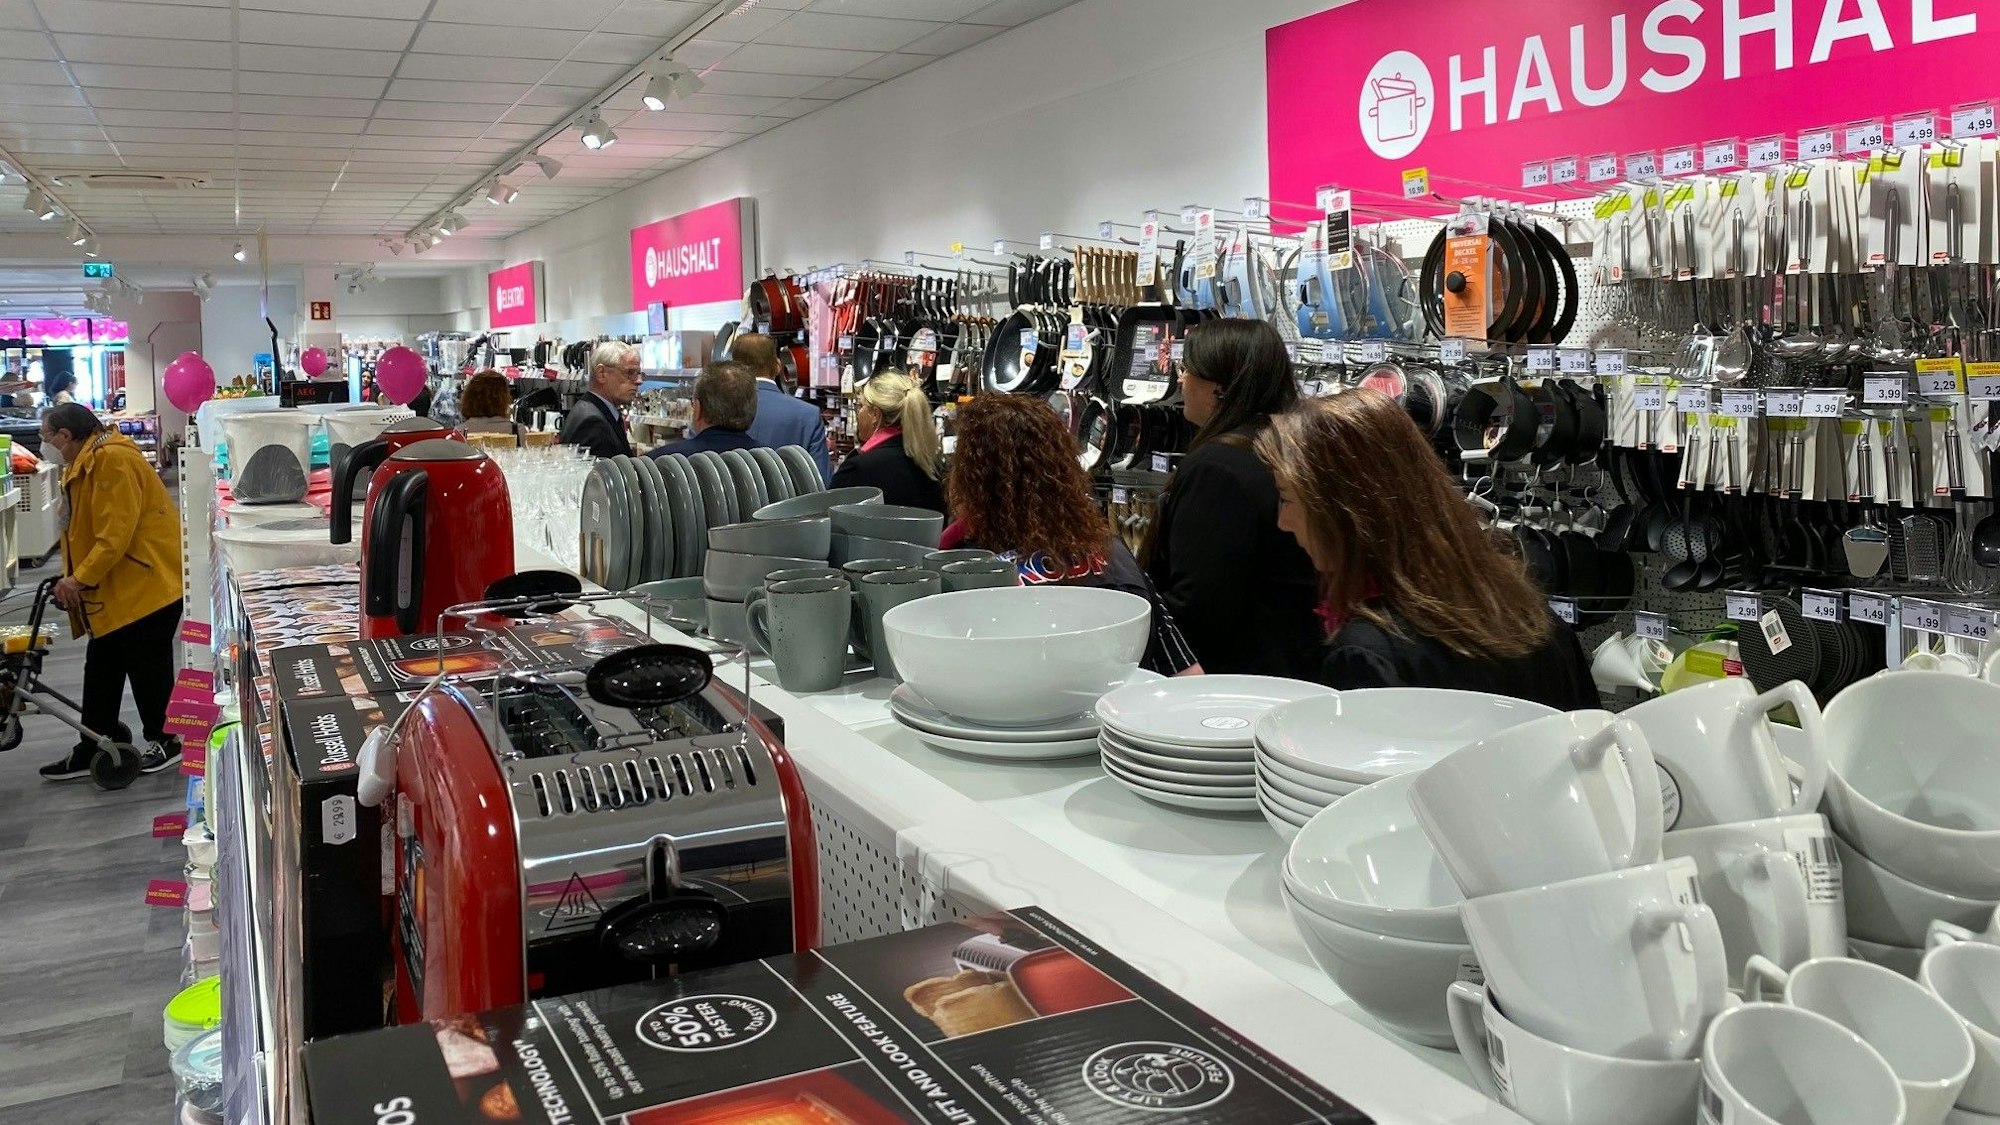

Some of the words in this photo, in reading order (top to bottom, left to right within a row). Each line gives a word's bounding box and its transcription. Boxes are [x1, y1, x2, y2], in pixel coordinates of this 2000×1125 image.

[1450, 0, 1976, 131] HAUSHAL
[1967, 118, 1993, 132] 4,99
[1908, 128, 1932, 140] 4,99
[1860, 135, 1882, 147] 4,99
[1811, 142, 1832, 154] 4,99
[1715, 154, 1734, 164] 4,99
[1760, 150, 1780, 162] 4,99
[1600, 166, 1616, 176] 3,49
[1637, 165, 1655, 175] 4,99
[1674, 160, 1692, 170] 4,99
[1532, 174, 1548, 184] 1,99
[1560, 169, 1576, 178] 2,99
[1450, 238, 1482, 249] UNIVERSAL
[658, 236, 721, 280] HAUSHALT
[1454, 248, 1477, 256] DECKEL
[1536, 358, 1550, 366] 3,99
[1570, 361, 1585, 369] 3,99
[1606, 363, 1622, 372] 3,99
[1933, 380, 1956, 391] 2,29
[1984, 385, 2000, 397] 2,2
[296, 388, 316, 396] AEG
[1878, 389, 1901, 400] 3,99
[1644, 398, 1660, 406] 3,99
[1688, 400, 1706, 408] 3,99
[1734, 404, 1752, 414] 3,99
[1778, 404, 1798, 413] 3,99
[1815, 404, 1836, 414] 3,99
[1738, 606, 1756, 616] 2,99
[1815, 606, 1834, 616] 4,99
[1863, 608, 1883, 620] 1,49
[1917, 616, 1938, 628] 1,99
[182, 630, 208, 638] WERBUNG
[1646, 626, 1662, 636] 9,99
[1963, 624, 1987, 636] 3,49
[292, 658, 316, 677] Hobbs
[177, 680, 209, 689] WERBUNG
[168, 716, 208, 727] WERBUNG
[310, 713, 342, 736] Hobbs
[314, 734, 350, 764] Russell
[154, 824, 182, 832] WERBUNG
[333, 832, 345, 840] €
[694, 1002, 736, 1040] FASTER
[826, 992, 884, 1038] FEATURE
[650, 1021, 664, 1032] TO
[660, 1006, 712, 1046] 50%
[656, 1031, 672, 1042] UP
[582, 1042, 602, 1063] faster
[871, 1036, 918, 1070] LOOK
[592, 1060, 612, 1078] 50%
[1093, 1057, 1114, 1084] LOOK
[1168, 1047, 1224, 1084] FEATURE
[618, 1064, 636, 1080] new
[604, 1076, 618, 1088] to
[907, 1068, 948, 1098] AND
[970, 1064, 1008, 1093] without
[608, 1085, 624, 1100] Up
[627, 1080, 644, 1094] our
[1010, 1078, 1038, 1098] cycle
[1106, 1084, 1120, 1092] &
[1002, 1092, 1032, 1114] toast
[1118, 1092, 1162, 1106] LIFT
[934, 1099, 977, 1125] LIFT
[1034, 1098, 1054, 1114] the
